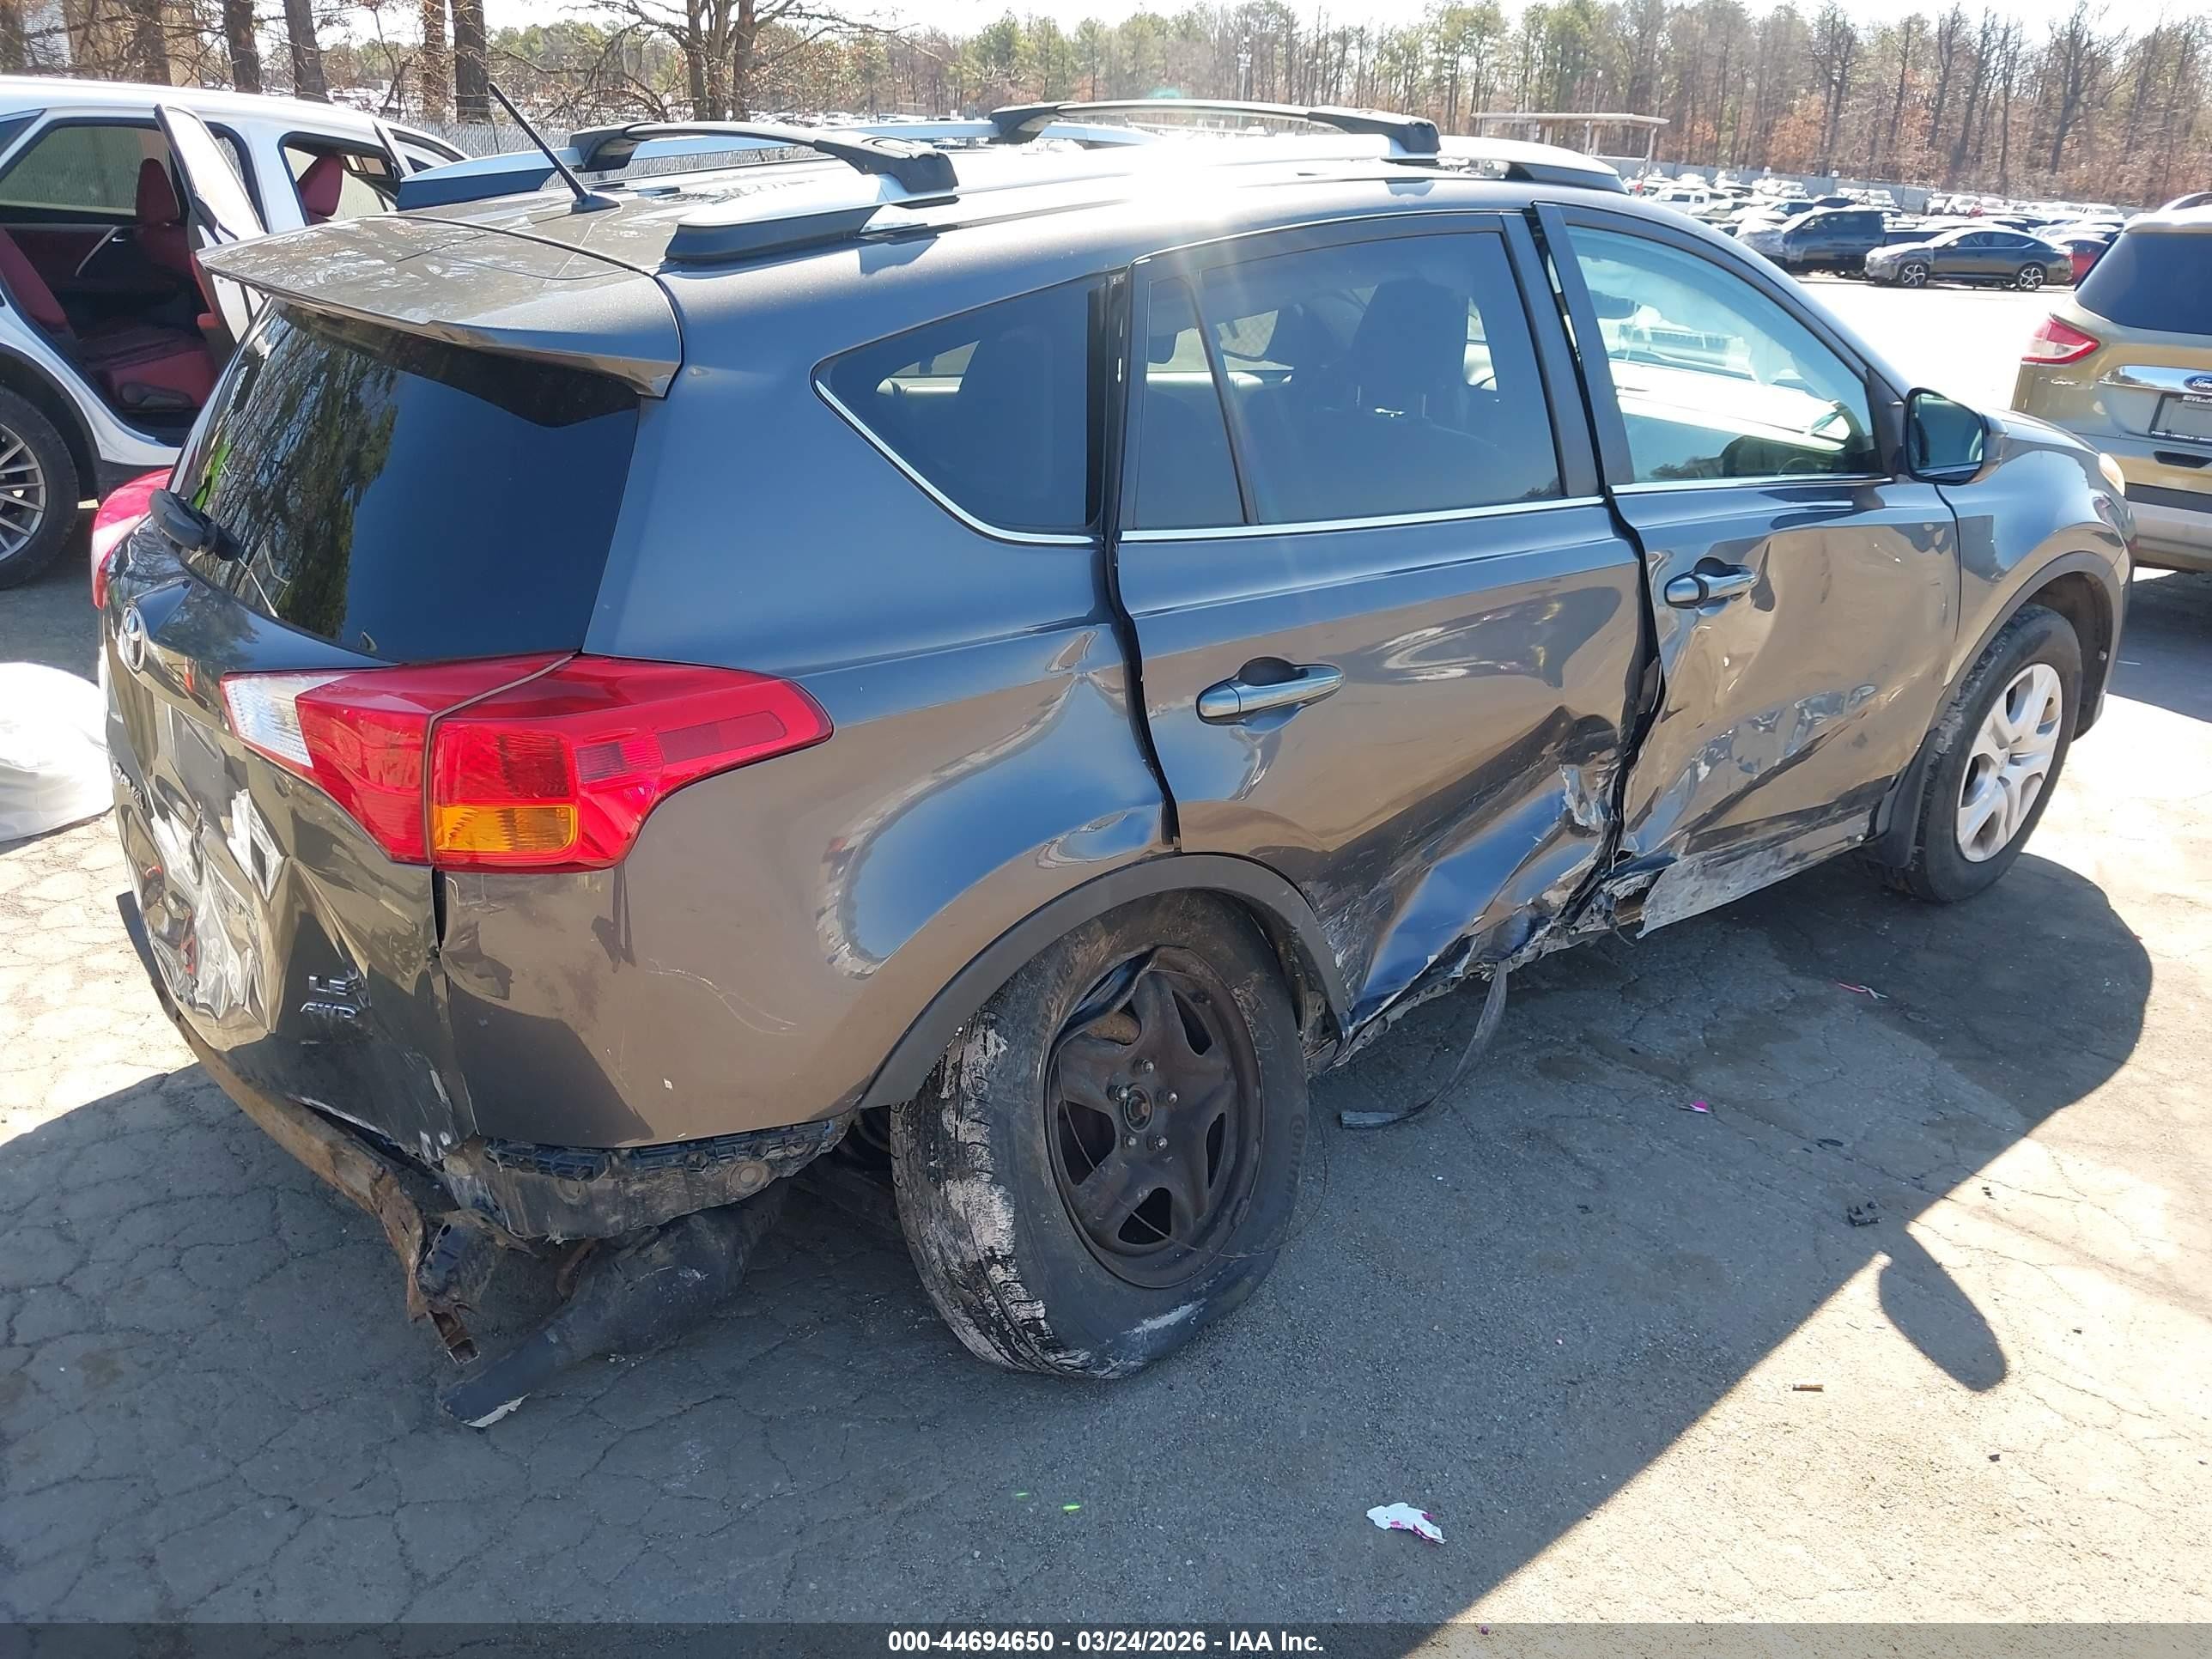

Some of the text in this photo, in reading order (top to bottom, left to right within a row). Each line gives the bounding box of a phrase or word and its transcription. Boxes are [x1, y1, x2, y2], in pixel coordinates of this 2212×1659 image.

[112, 763, 144, 809] RAV4
[308, 975, 348, 997] LE
[299, 1000, 358, 1021] AWD
